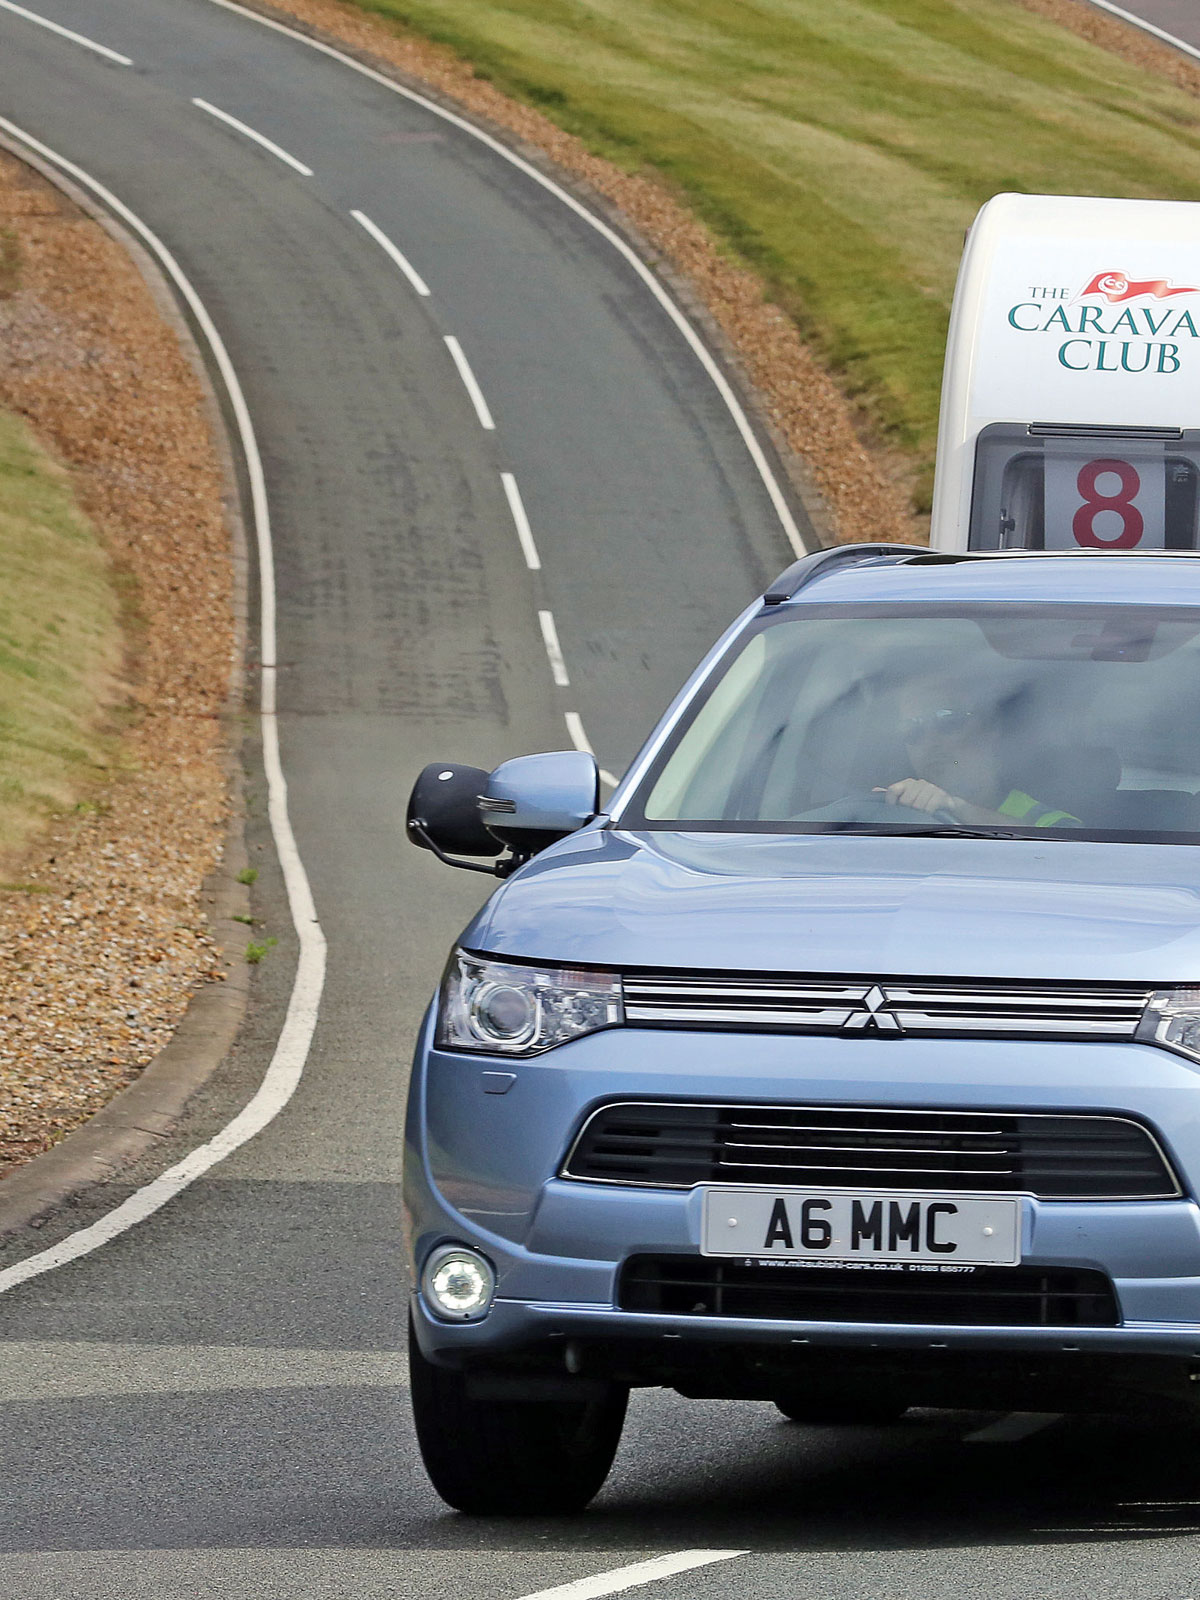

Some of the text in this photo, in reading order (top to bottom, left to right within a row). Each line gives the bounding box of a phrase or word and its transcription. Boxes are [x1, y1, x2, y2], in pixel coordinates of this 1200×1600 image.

[1027, 285, 1070, 300] THE
[1057, 338, 1182, 374] CLUB
[1072, 458, 1145, 549] 8
[763, 1197, 958, 1253] A6 MMC
[758, 1259, 904, 1271] www.mitsubishi-cars.co.uk
